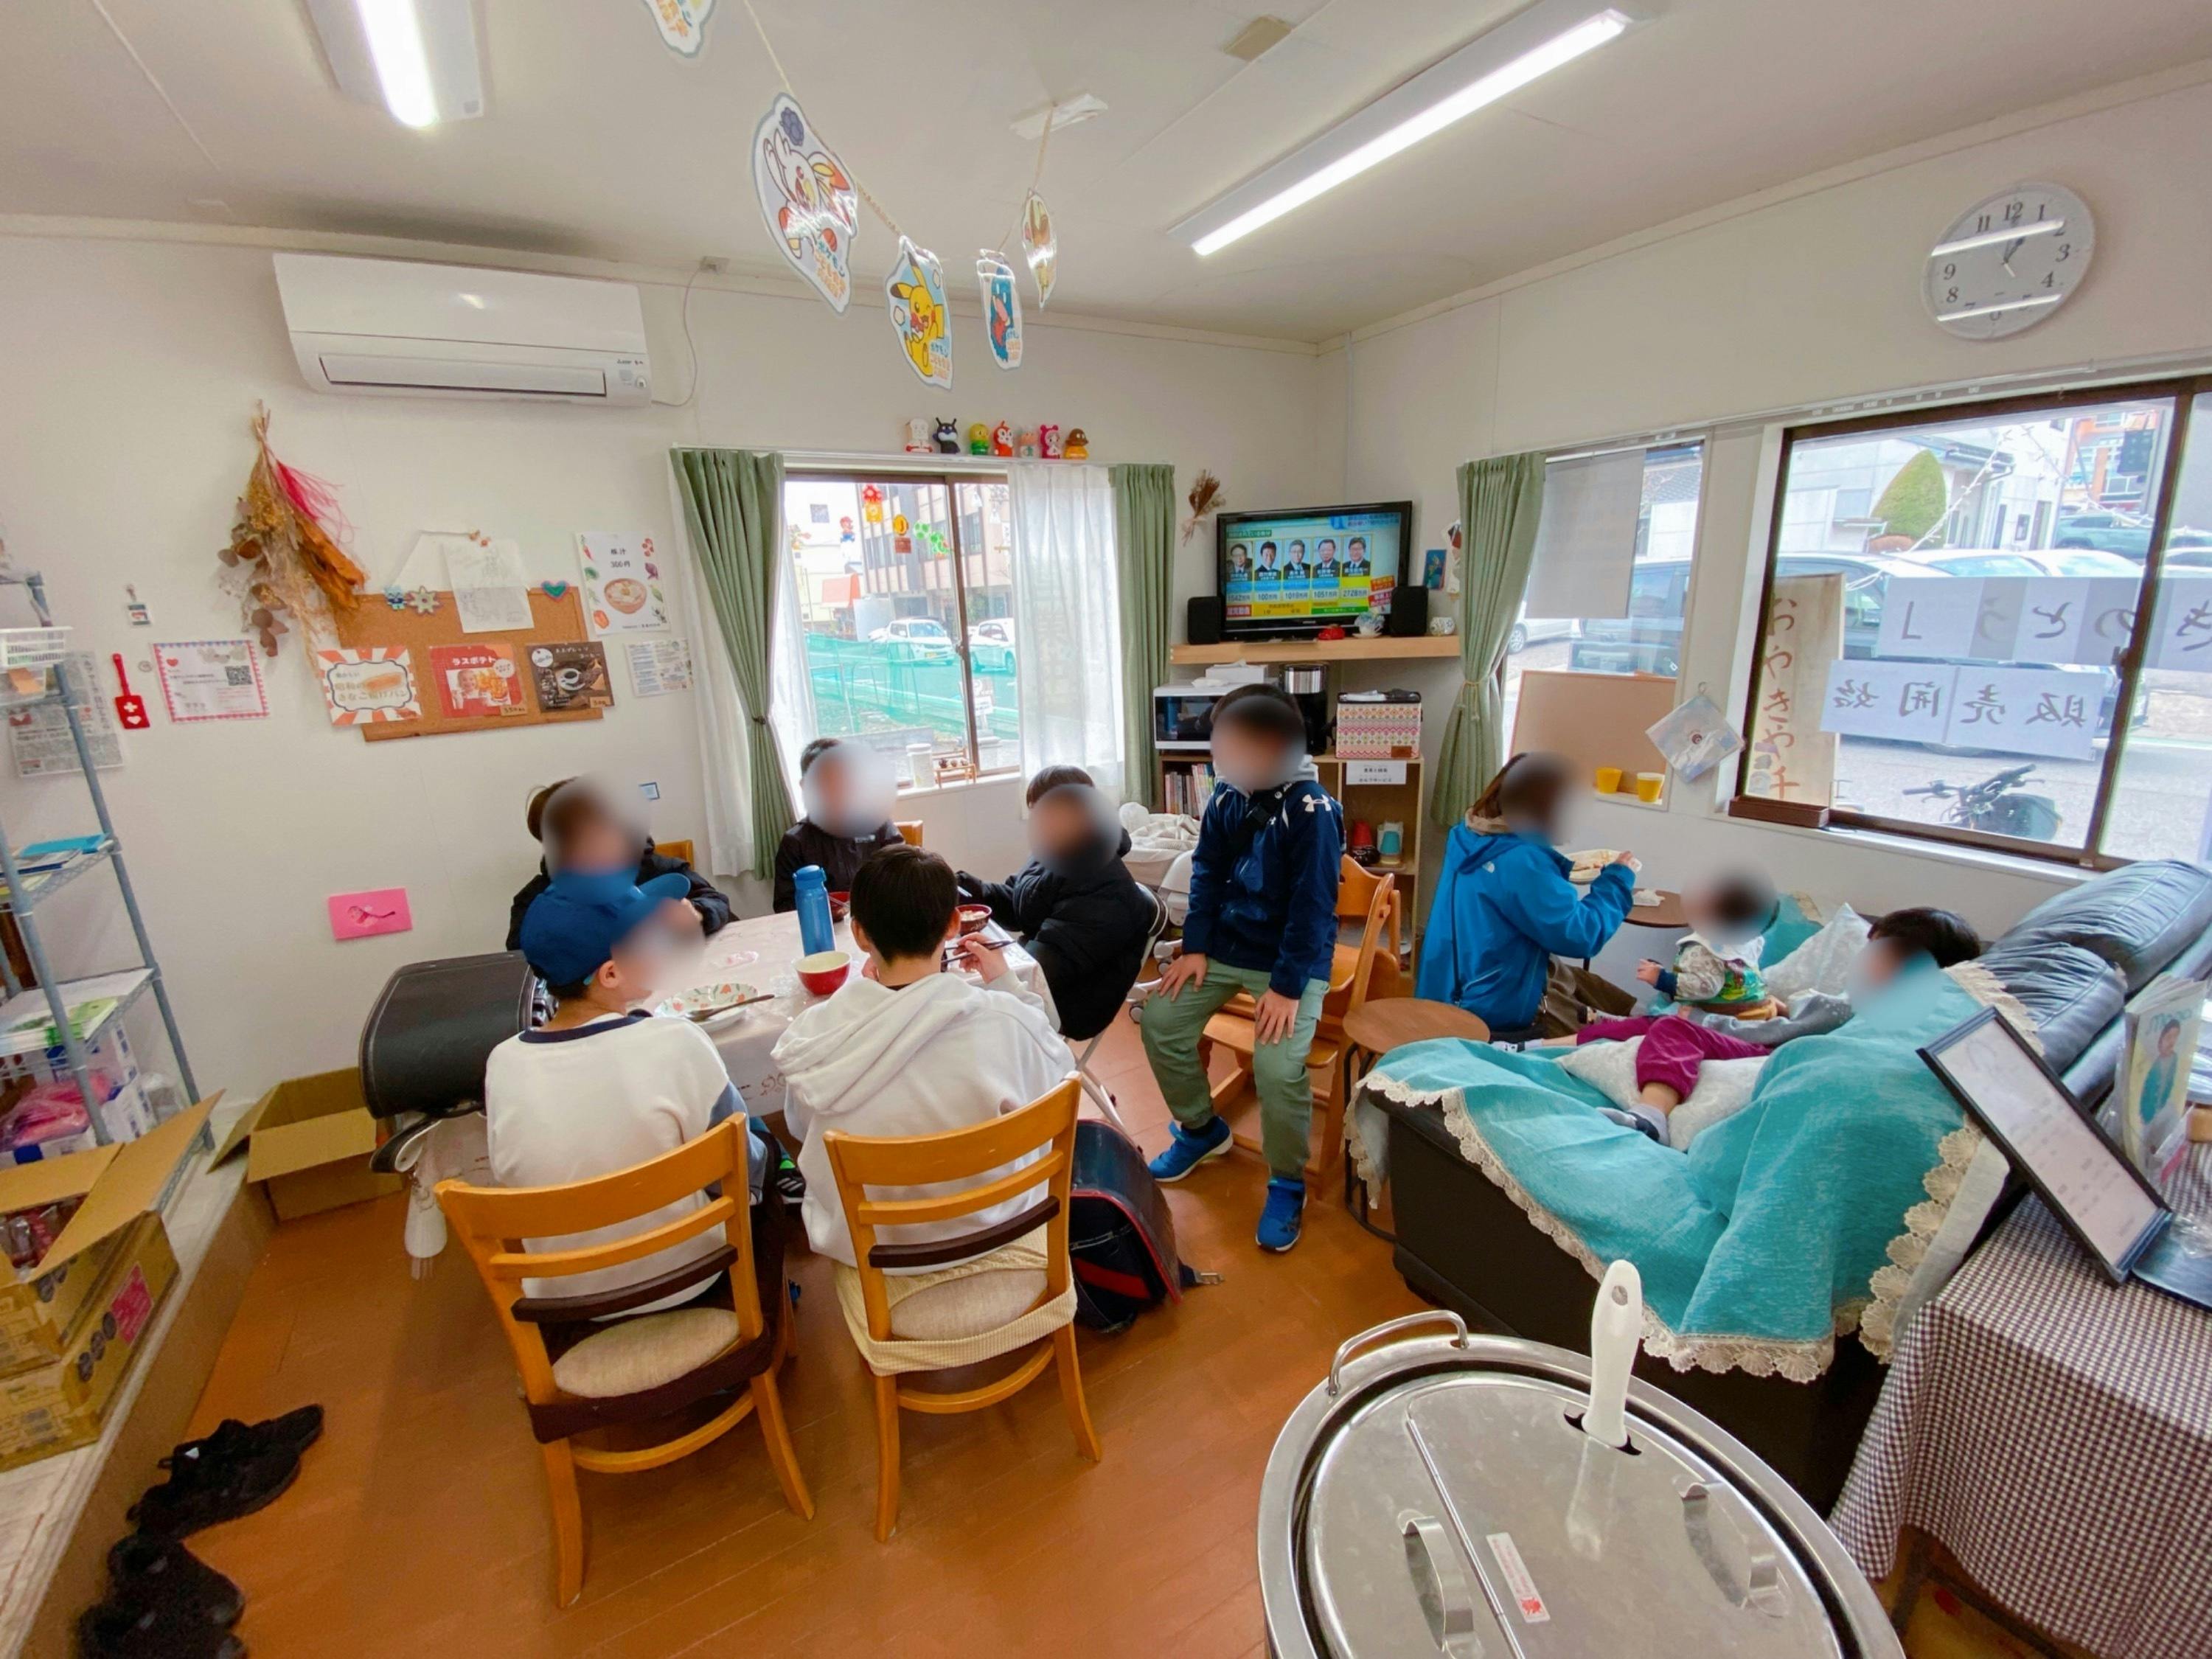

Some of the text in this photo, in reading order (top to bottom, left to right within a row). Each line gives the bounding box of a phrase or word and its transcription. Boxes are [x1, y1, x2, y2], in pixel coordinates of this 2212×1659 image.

[2003, 201, 2023, 221] 12
[2037, 204, 2045, 221] 1
[1976, 215, 1992, 233] 11
[2056, 244, 2071, 262] 3
[1944, 263, 1956, 280] 9
[2041, 271, 2055, 288] 4
[1946, 286, 1959, 303] 8
[453, 655, 496, 666] ラスポテト
